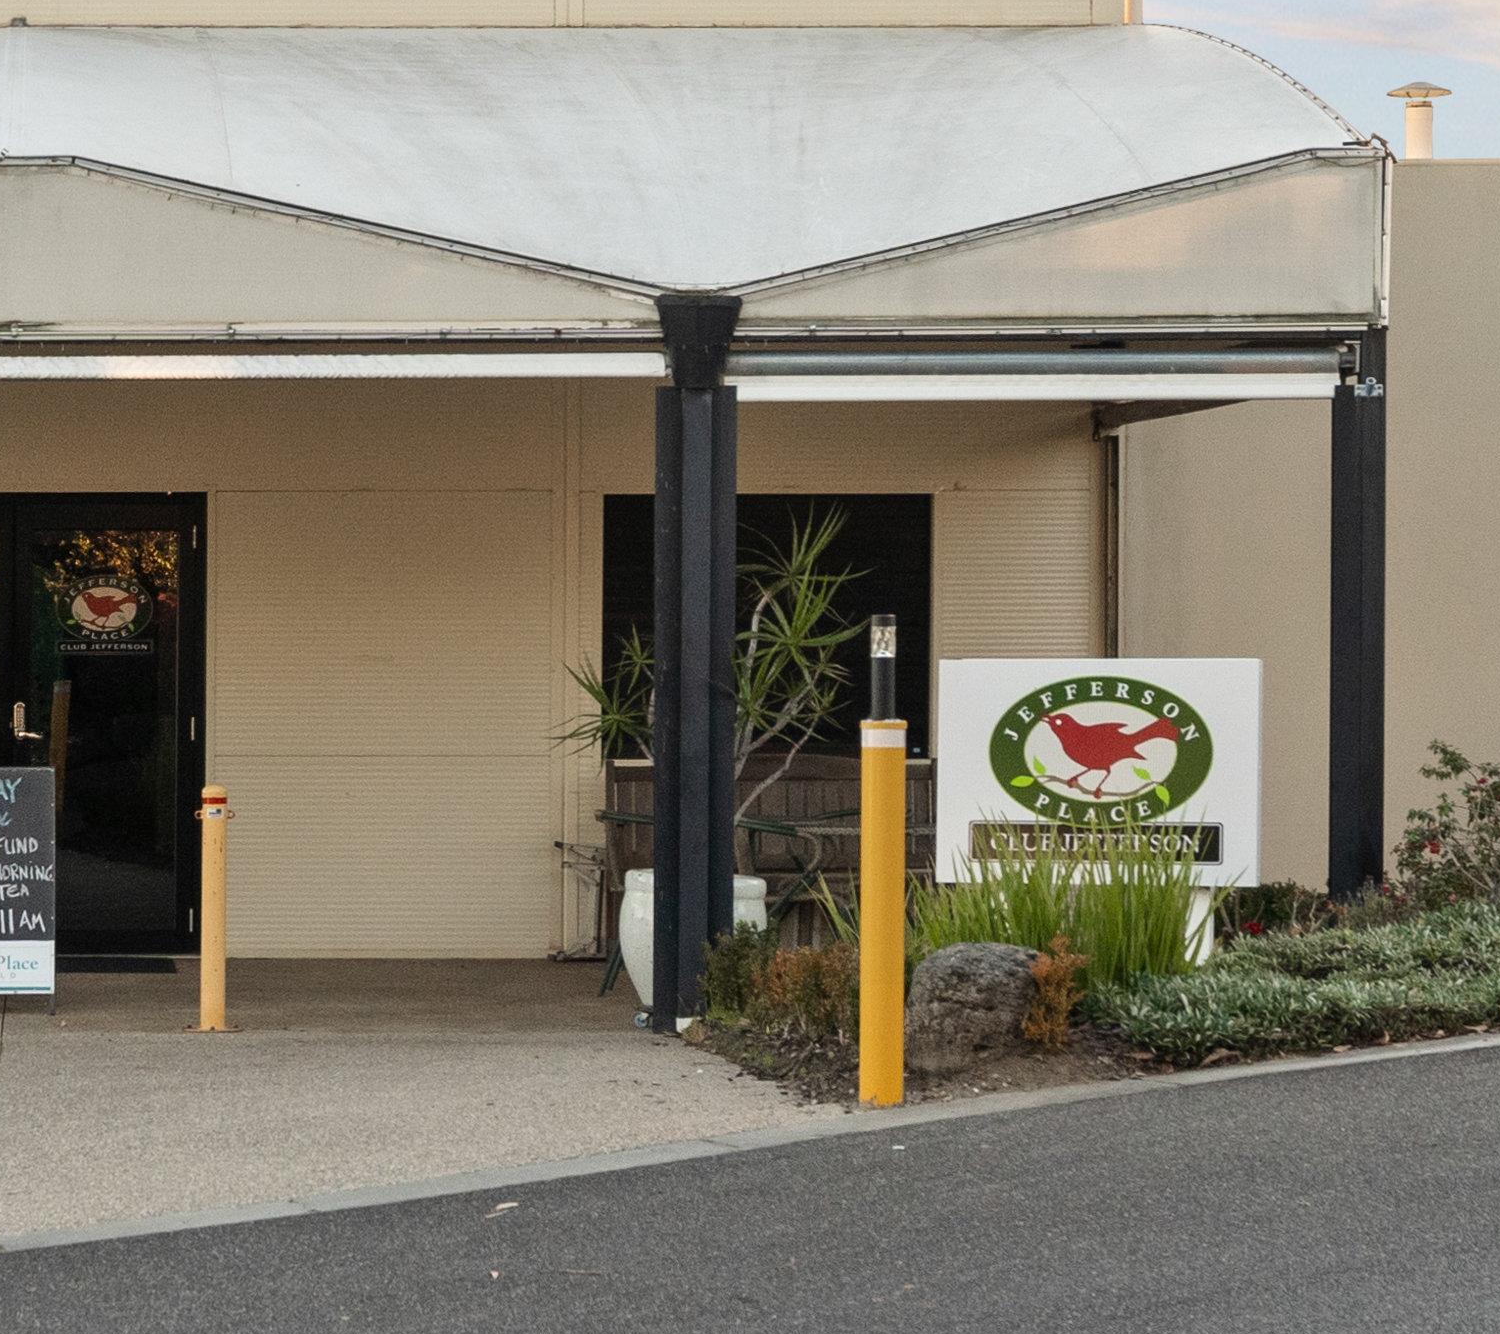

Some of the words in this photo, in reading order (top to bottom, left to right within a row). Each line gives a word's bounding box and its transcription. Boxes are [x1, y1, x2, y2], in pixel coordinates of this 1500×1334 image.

[64, 578, 147, 604] JEFFERSON
[60, 643, 87, 651] CLUB
[90, 643, 148, 651] JEFFERSON
[82, 629, 128, 640] PLACE
[1004, 681, 1200, 743] JEFFERSON
[1034, 793, 1151, 823] PLACE
